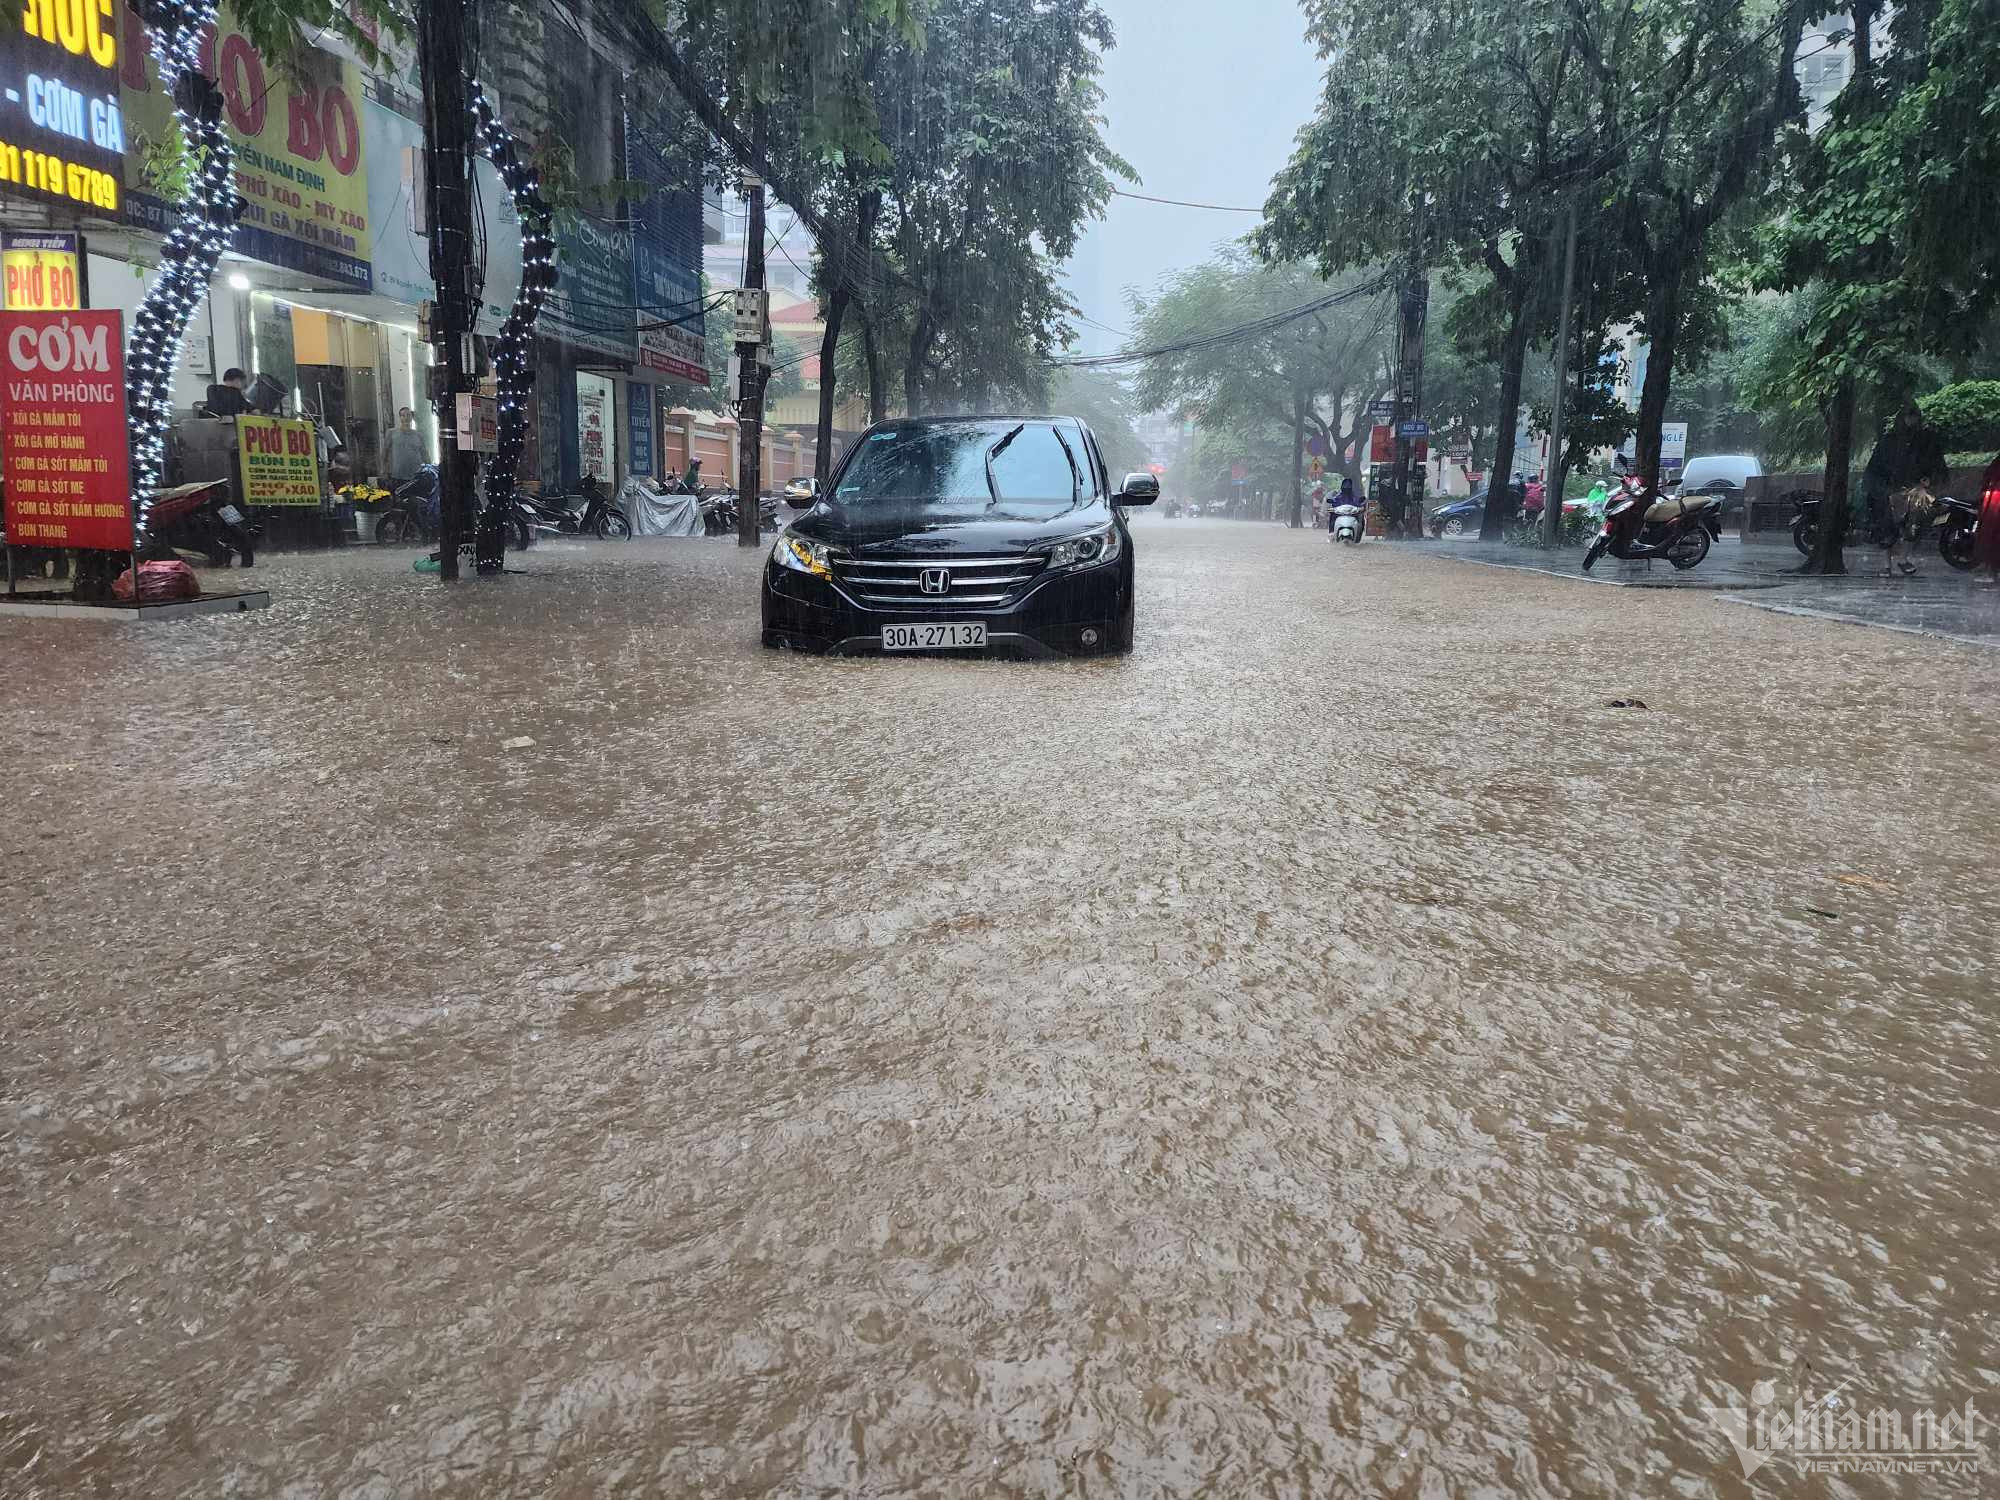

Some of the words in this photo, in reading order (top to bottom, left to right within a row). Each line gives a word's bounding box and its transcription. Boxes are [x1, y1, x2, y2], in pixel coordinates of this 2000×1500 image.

[27, 73, 87, 142] CƠM
[90, 93, 127, 155] GÀ
[23, 149, 64, 195] 119
[66, 162, 118, 210] 6789
[265, 157, 294, 182] NAM
[296, 167, 326, 193] ĐỊNH
[340, 209, 365, 231] XÀO
[7, 251, 44, 306] PHỞ
[49, 256, 75, 308] BÒ
[8, 316, 111, 372] CƠM
[8, 379, 48, 402] VĂN
[52, 379, 115, 402] PHÒNG
[29, 409, 41, 425] GÀ
[30, 432, 43, 448] GÀ
[60, 432, 85, 449] HÀNH
[287, 424, 311, 456] BÒ
[15, 456, 34, 470] CƠM
[37, 455, 49, 471] GÀ
[16, 479, 36, 493] CƠM
[38, 477, 50, 494] GÀ
[70, 481, 85, 494] ME
[17, 500, 37, 515] CƠM
[39, 499, 51, 515] GÀ
[94, 503, 125, 518] HƯƠNG
[18, 521, 36, 536] BÚN
[39, 524, 67, 538] THANG
